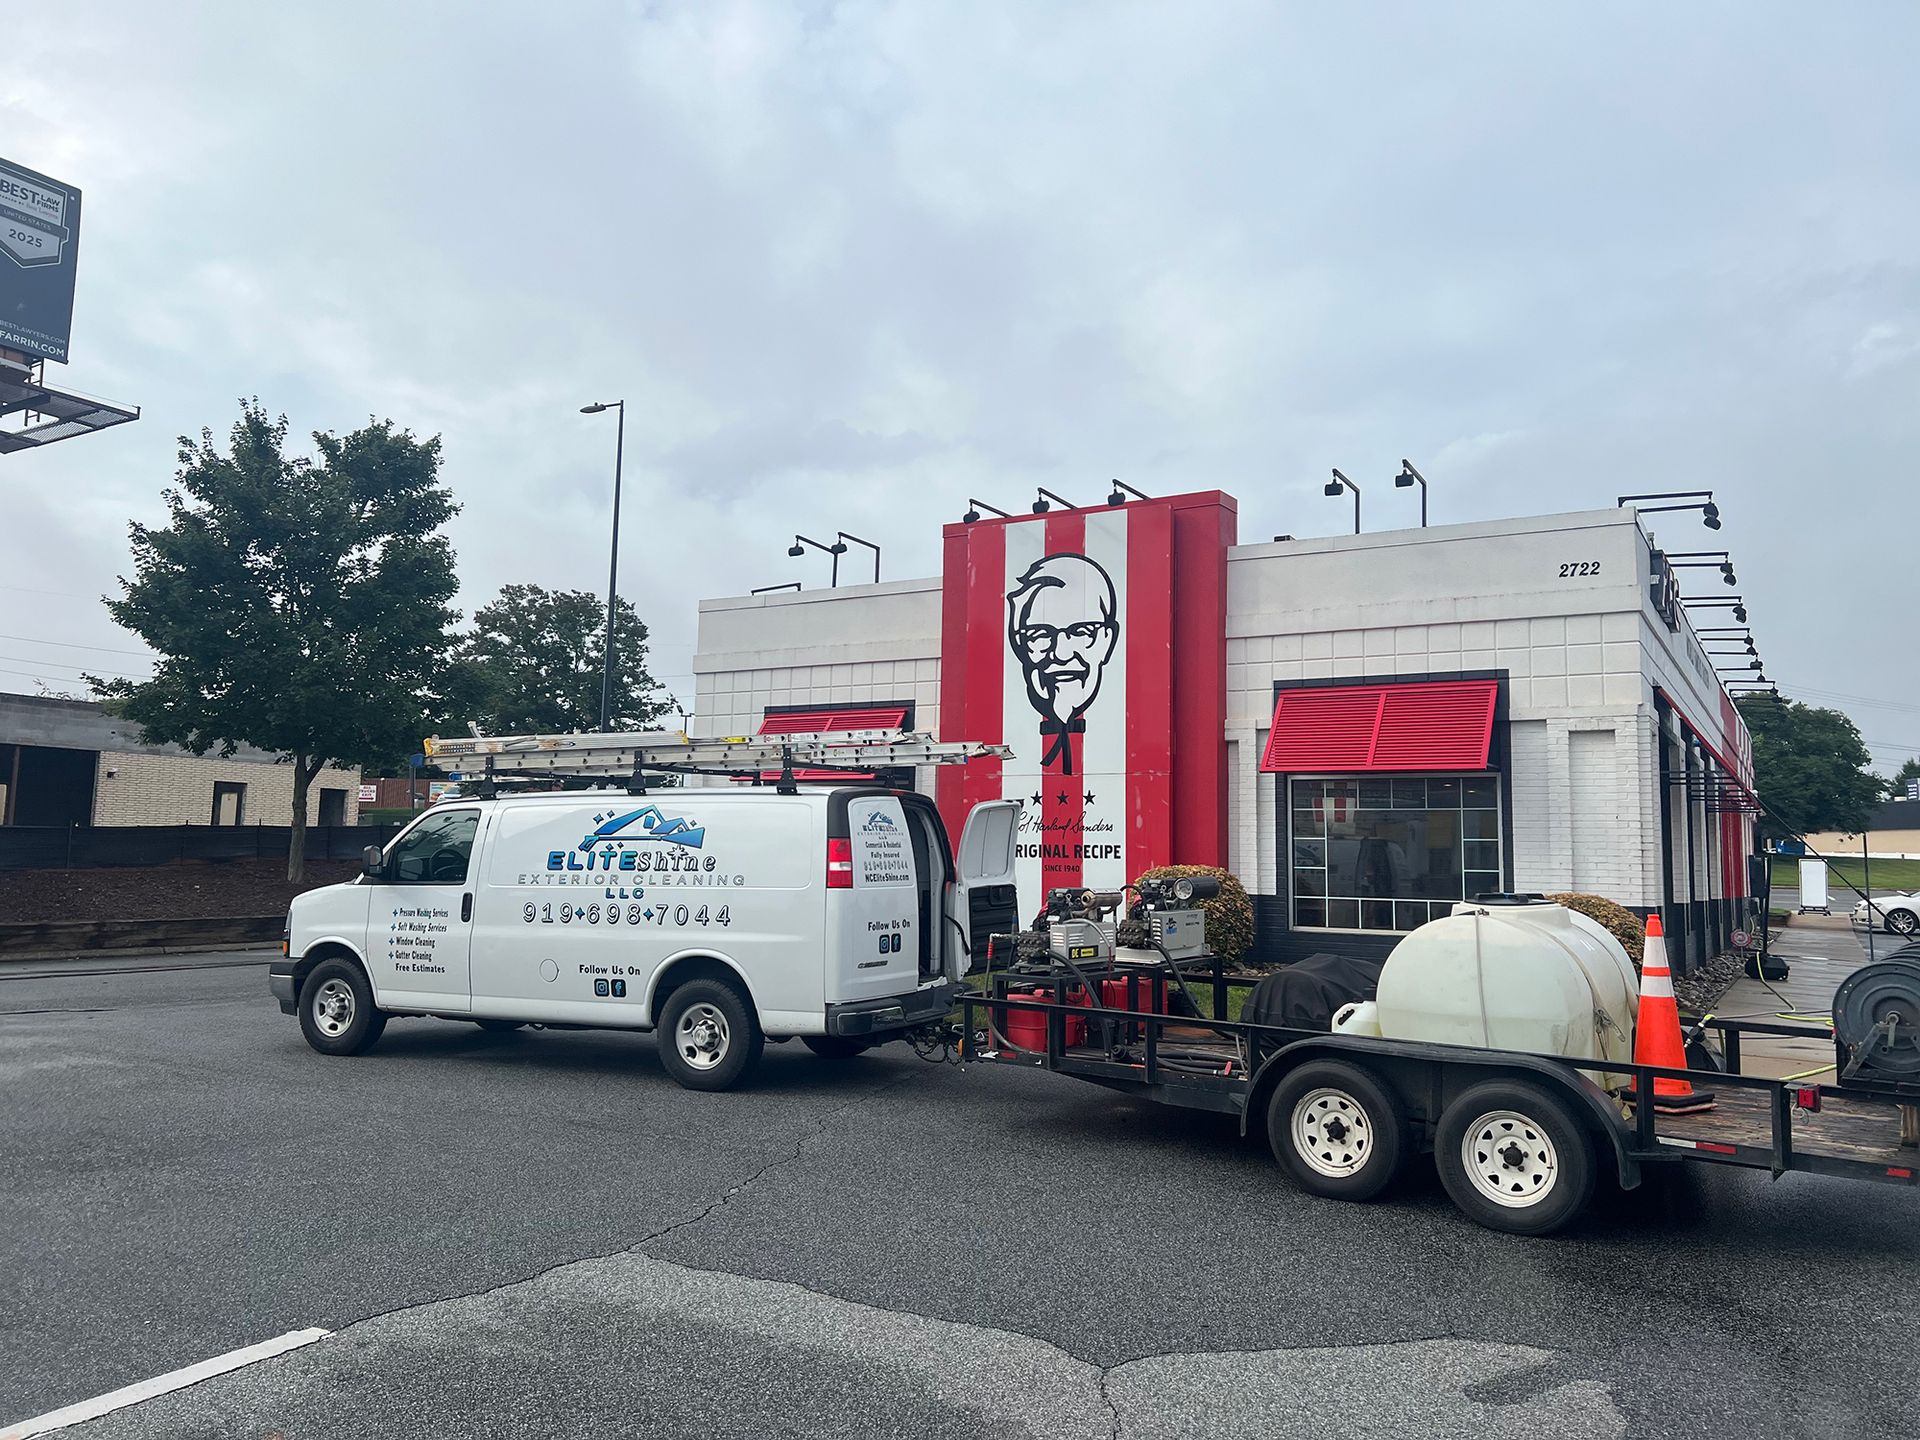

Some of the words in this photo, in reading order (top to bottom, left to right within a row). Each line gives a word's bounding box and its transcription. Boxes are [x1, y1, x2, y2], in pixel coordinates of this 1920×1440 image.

[0, 179, 40, 204] BEST
[37, 200, 59, 213] FIRMS
[41, 194, 60, 206] LAW
[4, 209, 27, 222] UNITED
[28, 216, 51, 231] STATES
[9, 229, 43, 248] 2025
[0, 331, 65, 357] FARRIN.COM
[1559, 561, 1601, 578] 2722
[1071, 811, 1113, 834] Sanders
[871, 851, 882, 859] Fully
[883, 851, 900, 859] Insured
[1015, 844, 1069, 859] RIGINAL
[1074, 844, 1121, 859] RECIPE
[1044, 864, 1062, 872] SINCE
[1064, 864, 1080, 873] 1940
[518, 874, 619, 886] EXTERIOR
[632, 874, 745, 887] CLEANING
[605, 887, 645, 900] LLC
[428, 923, 447, 932] Services
[868, 921, 889, 931] Follow
[892, 920, 900, 929] Us
[902, 918, 910, 928] On
[396, 936, 413, 946] Window
[415, 937, 435, 949] Cleaning
[412, 950, 432, 962] Cleaning
[395, 963, 410, 971] Free
[412, 963, 445, 973] Estimates
[579, 964, 608, 975] Follow
[612, 965, 624, 975] Us
[628, 966, 640, 975] On
